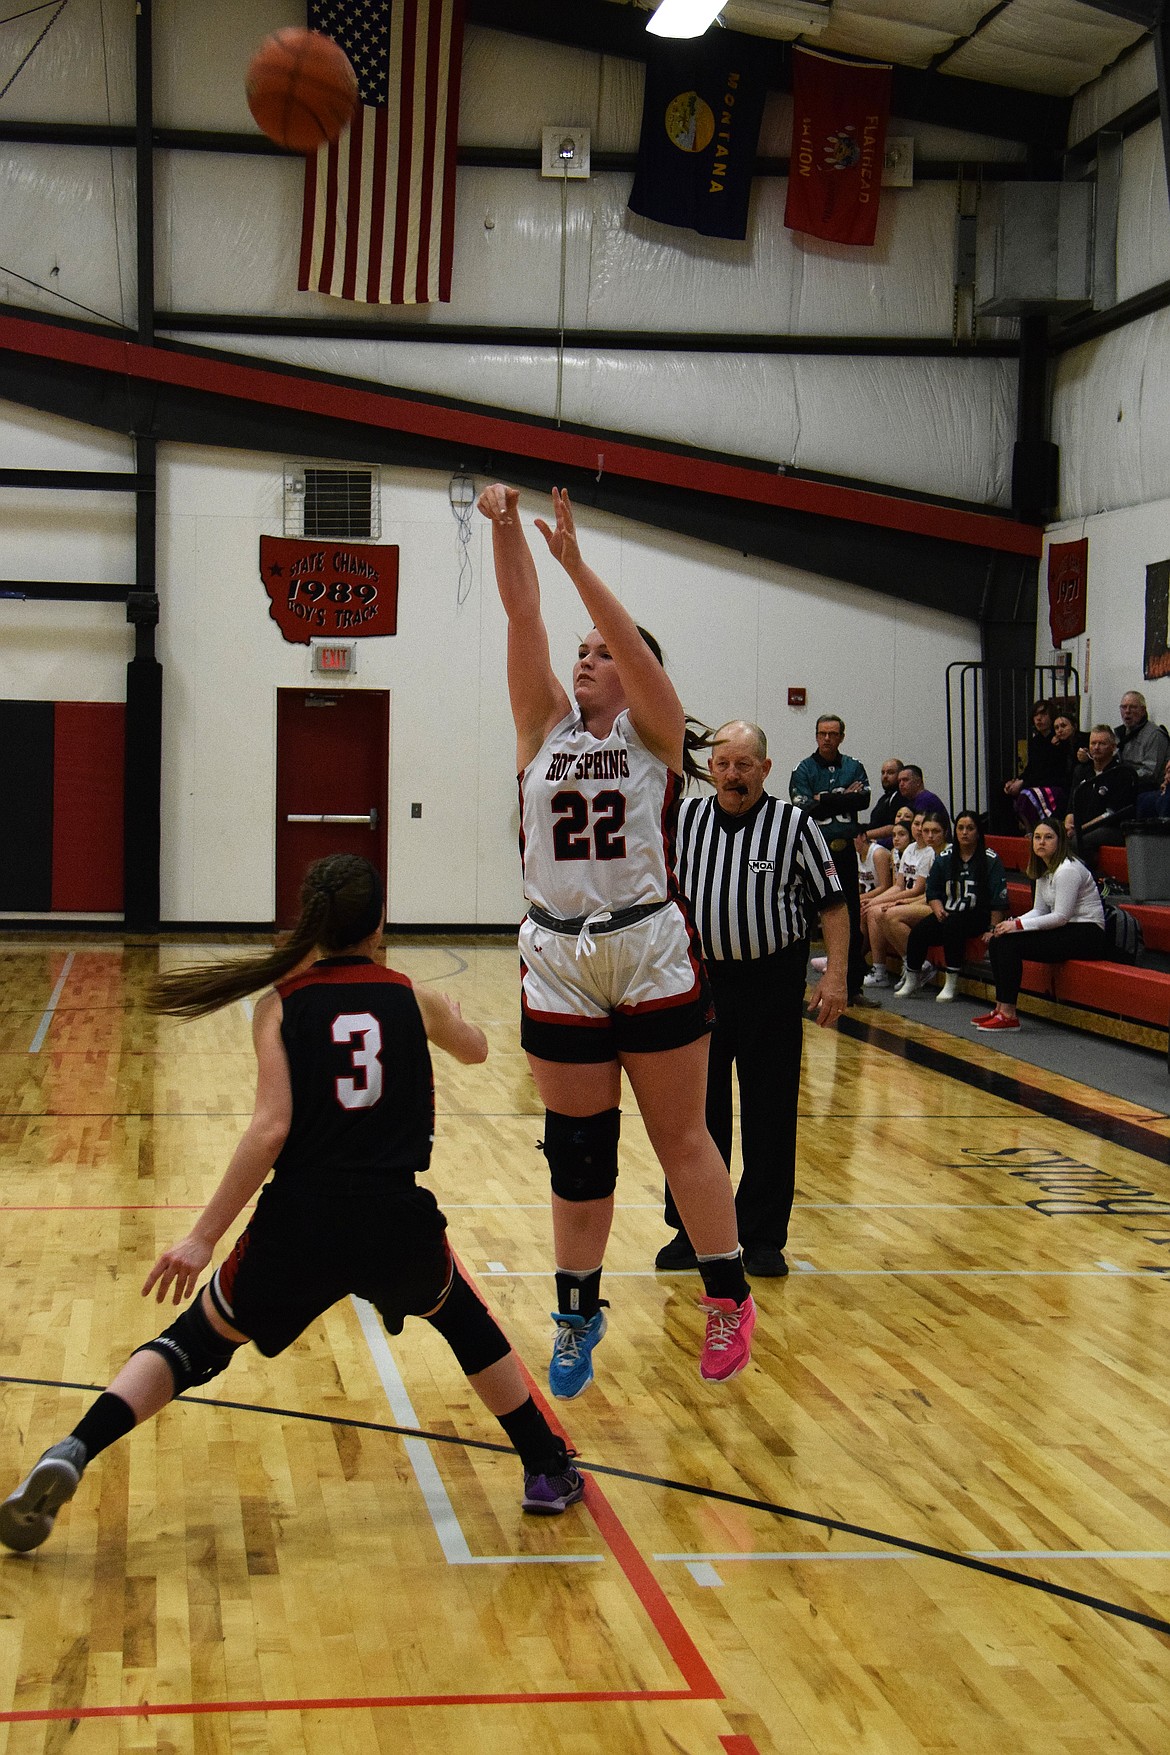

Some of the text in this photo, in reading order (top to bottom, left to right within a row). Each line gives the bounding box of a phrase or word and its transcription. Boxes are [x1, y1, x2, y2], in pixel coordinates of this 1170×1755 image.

[708, 71, 741, 193] MONTANA
[859, 115, 879, 203] FLATHEAD
[289, 551, 380, 583] STATE CHAMPS
[287, 579, 378, 605] 1989
[335, 604, 379, 629] TRACK
[321, 648, 348, 669] EXIT
[545, 752, 578, 781] HOT
[550, 788, 628, 862] 22
[329, 1010, 385, 1110] 3
